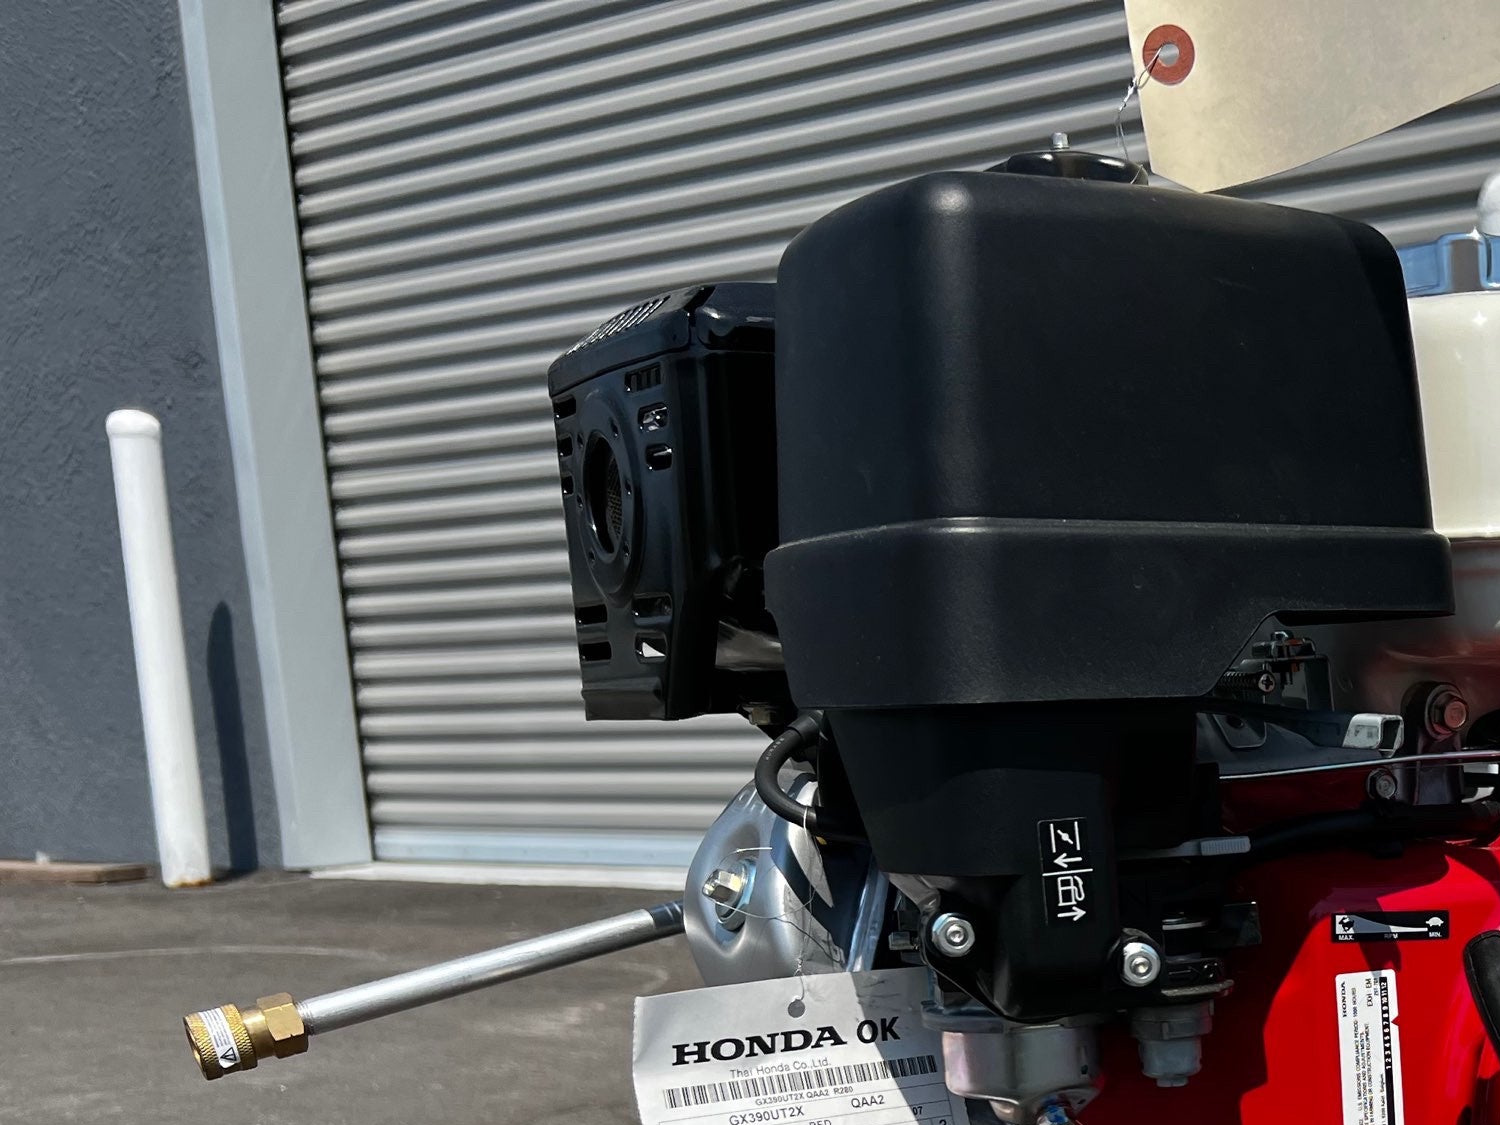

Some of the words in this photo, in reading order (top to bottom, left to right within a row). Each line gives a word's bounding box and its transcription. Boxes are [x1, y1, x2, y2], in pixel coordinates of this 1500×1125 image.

[672, 1026, 847, 1066] HONDA
[856, 1016, 900, 1043] OK
[730, 1068, 753, 1079] Thai
[756, 1063, 790, 1076] Honda
[806, 1089, 830, 1099] QAA2
[834, 1086, 854, 1095] R280
[729, 1106, 805, 1125] GX390UT2X
[851, 1095, 885, 1109] QAA2
[912, 1106, 923, 1115] 07
